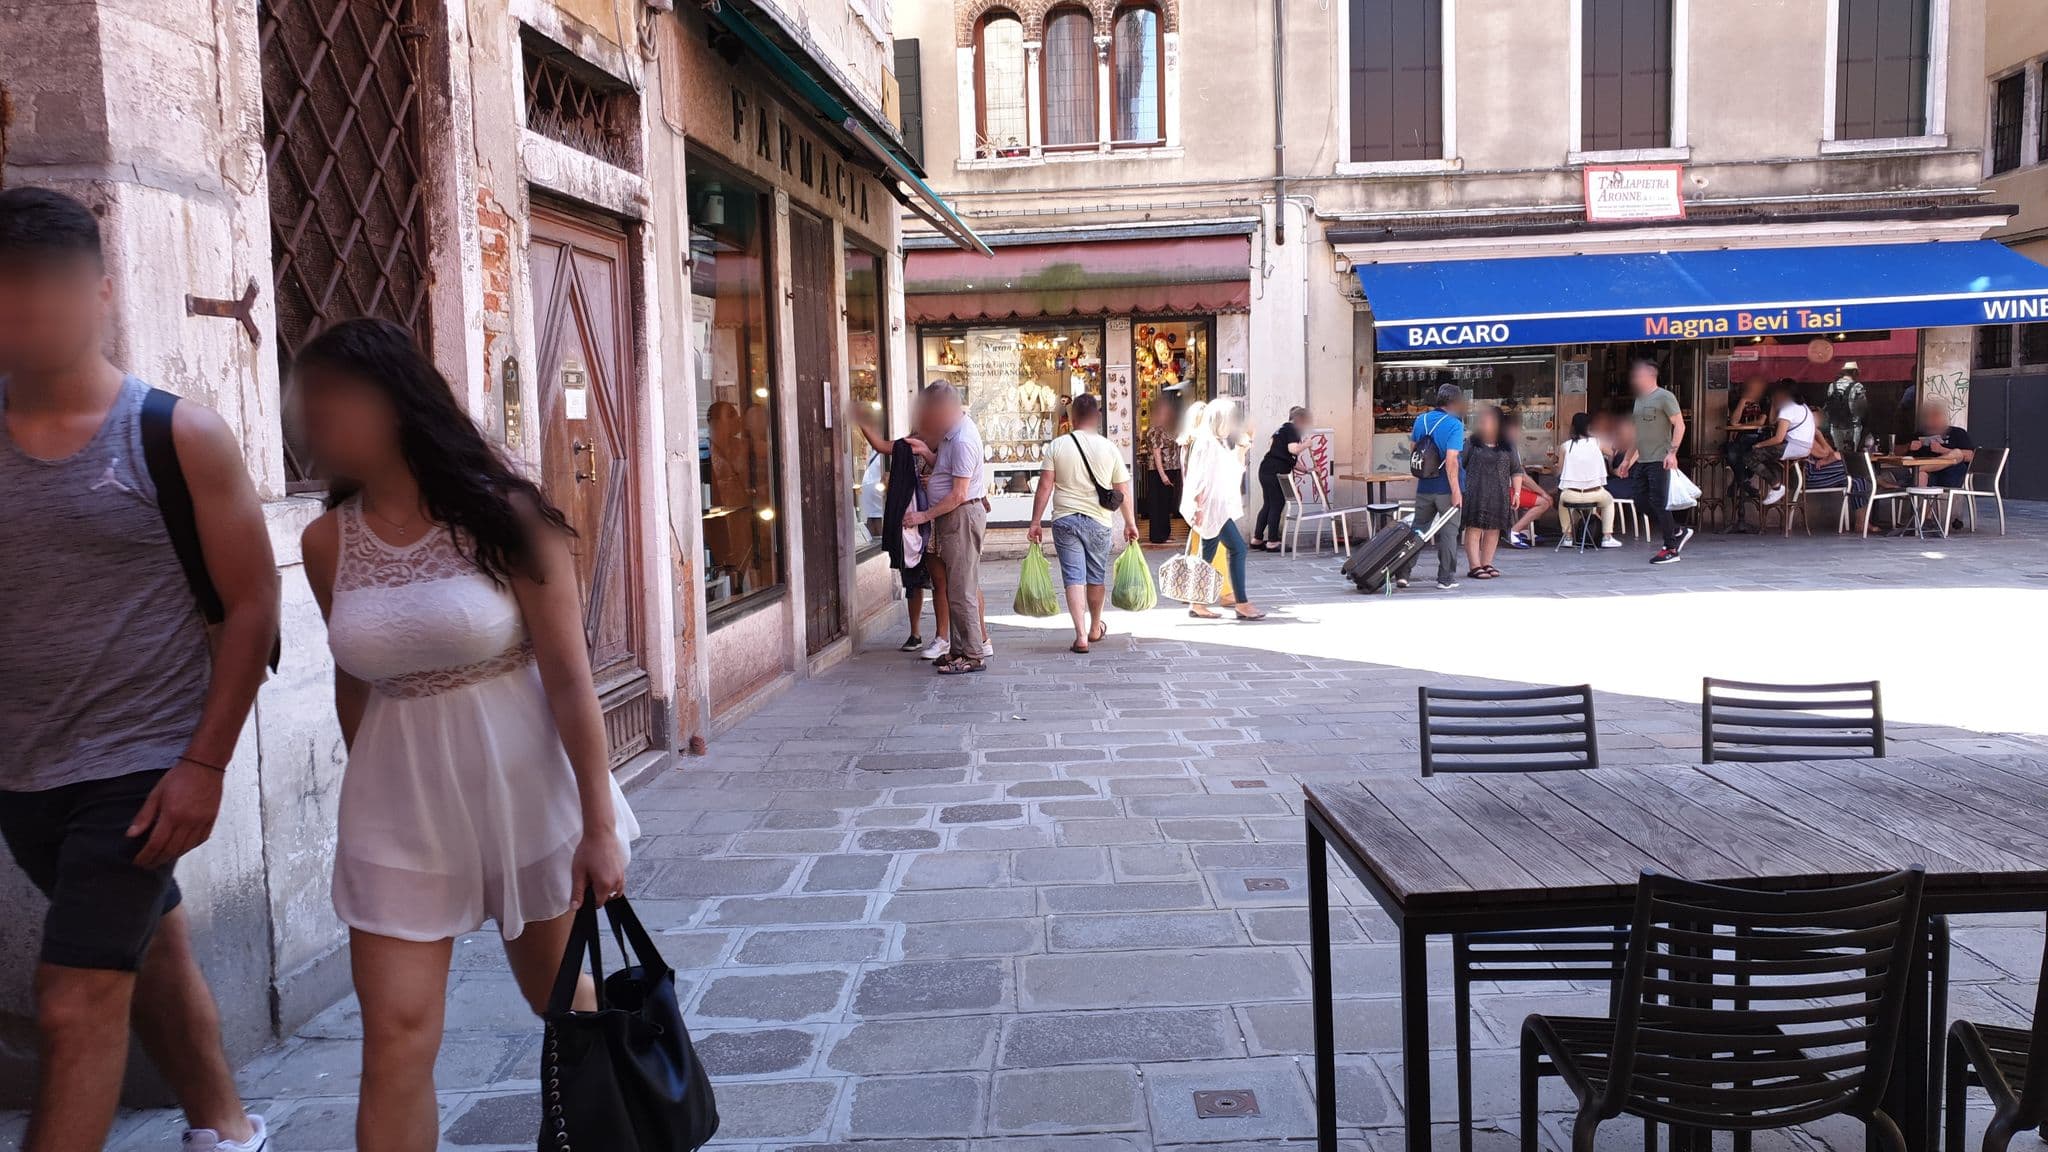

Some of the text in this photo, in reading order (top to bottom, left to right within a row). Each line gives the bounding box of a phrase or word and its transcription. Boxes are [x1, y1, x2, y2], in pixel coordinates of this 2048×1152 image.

[728, 83, 870, 225] FARMACIA
[1597, 176, 1670, 190] TAGLIAPIETRA
[1597, 189, 1642, 202] ARONNE
[1645, 307, 1842, 338] Magna Bevi Tasi
[1408, 323, 1510, 347] BACARO
